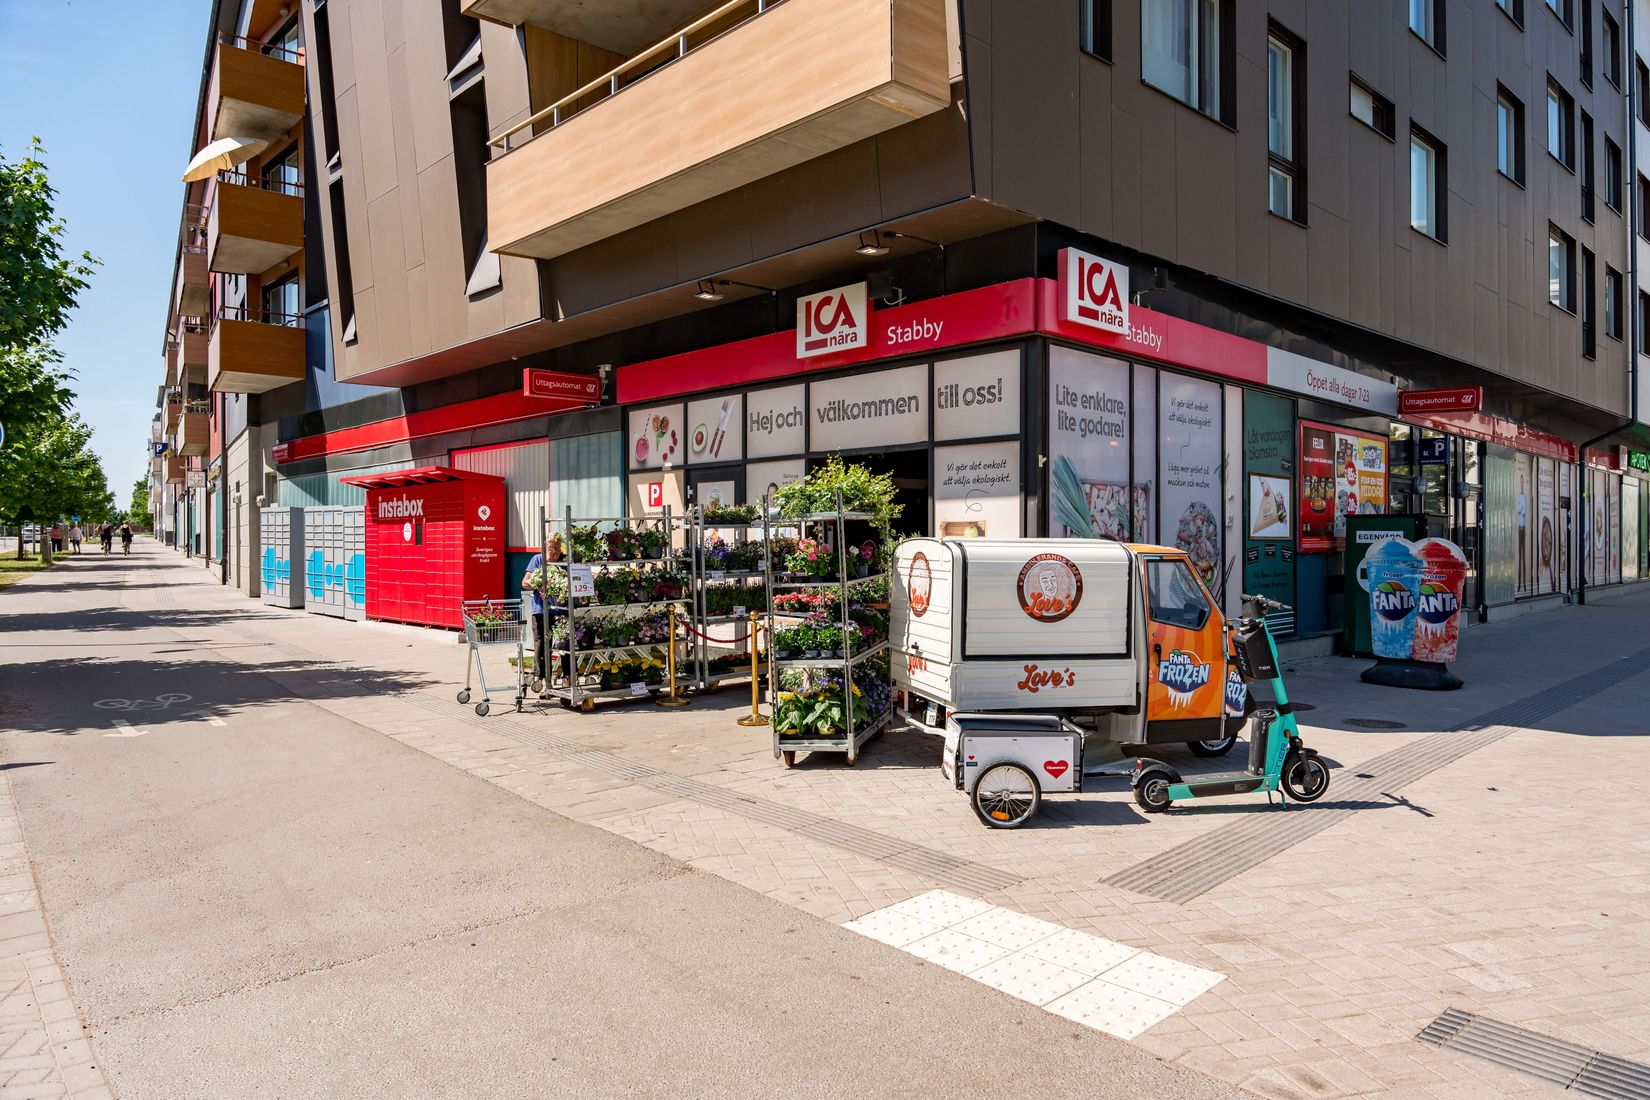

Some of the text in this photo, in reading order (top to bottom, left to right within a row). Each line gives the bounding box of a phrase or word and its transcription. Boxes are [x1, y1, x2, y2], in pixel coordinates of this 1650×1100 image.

[1078, 257, 1123, 312] ICA
[805, 292, 857, 338] ICA
[1100, 309, 1124, 328] nära
[829, 330, 857, 347] nära
[887, 318, 943, 345] Stabby
[1125, 322, 1162, 352] Stabby
[535, 379, 581, 389] Uttagsautomat
[1307, 368, 1327, 392] Öppet
[1329, 377, 1340, 393] alla
[1341, 381, 1358, 402] dagar
[750, 378, 1003, 434] Hej och välkommen till oss!
[1056, 384, 1126, 418] Lite enklare,
[1405, 397, 1456, 407] Uttagsautomat
[1058, 410, 1124, 438] lite godare!
[1435, 442, 1445, 456] P
[947, 459, 1007, 474] Vi gör det enkelt
[943, 475, 953, 486] att
[954, 474, 971, 486] välja
[378, 493, 424, 518] instabox
[650, 484, 660, 505] P
[1024, 592, 1073, 617] Love's
[1372, 590, 1415, 611] FANTA
[1419, 592, 1458, 613] ANTA
[1169, 653, 1191, 664] FANTA
[1017, 664, 1076, 693] Love's
[1159, 661, 1210, 689] FROZEN
[1275, 743, 1288, 770] TIER
